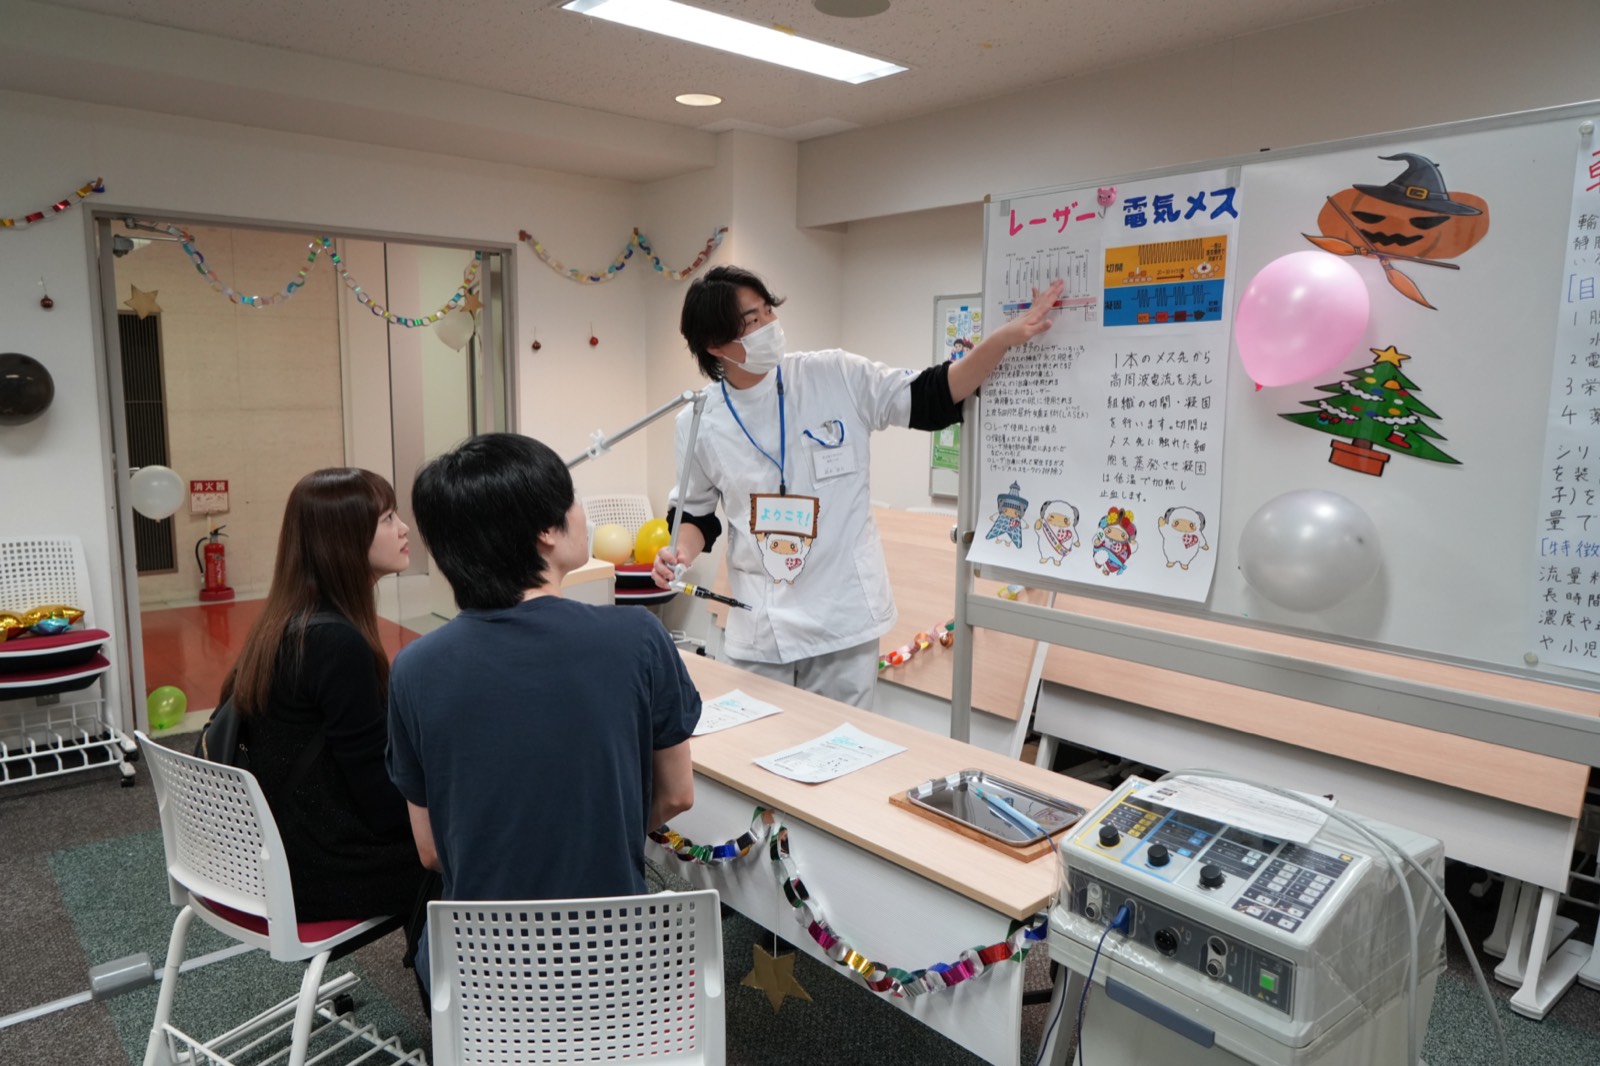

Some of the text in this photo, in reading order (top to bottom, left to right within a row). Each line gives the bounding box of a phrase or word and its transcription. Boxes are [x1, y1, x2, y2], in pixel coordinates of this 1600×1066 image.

[1123, 187, 1239, 228] 電気メス
[1009, 201, 1096, 236] レーザー
[1110, 371, 1213, 388] 高周波電流を流し
[1110, 435, 1206, 454] メス先に触れた細
[193, 481, 226, 492] 消火器
[1102, 472, 1187, 491] は低温で加熱し
[1099, 489, 1147, 503] 止血します。
[1538, 609, 1600, 632] 濃度や
